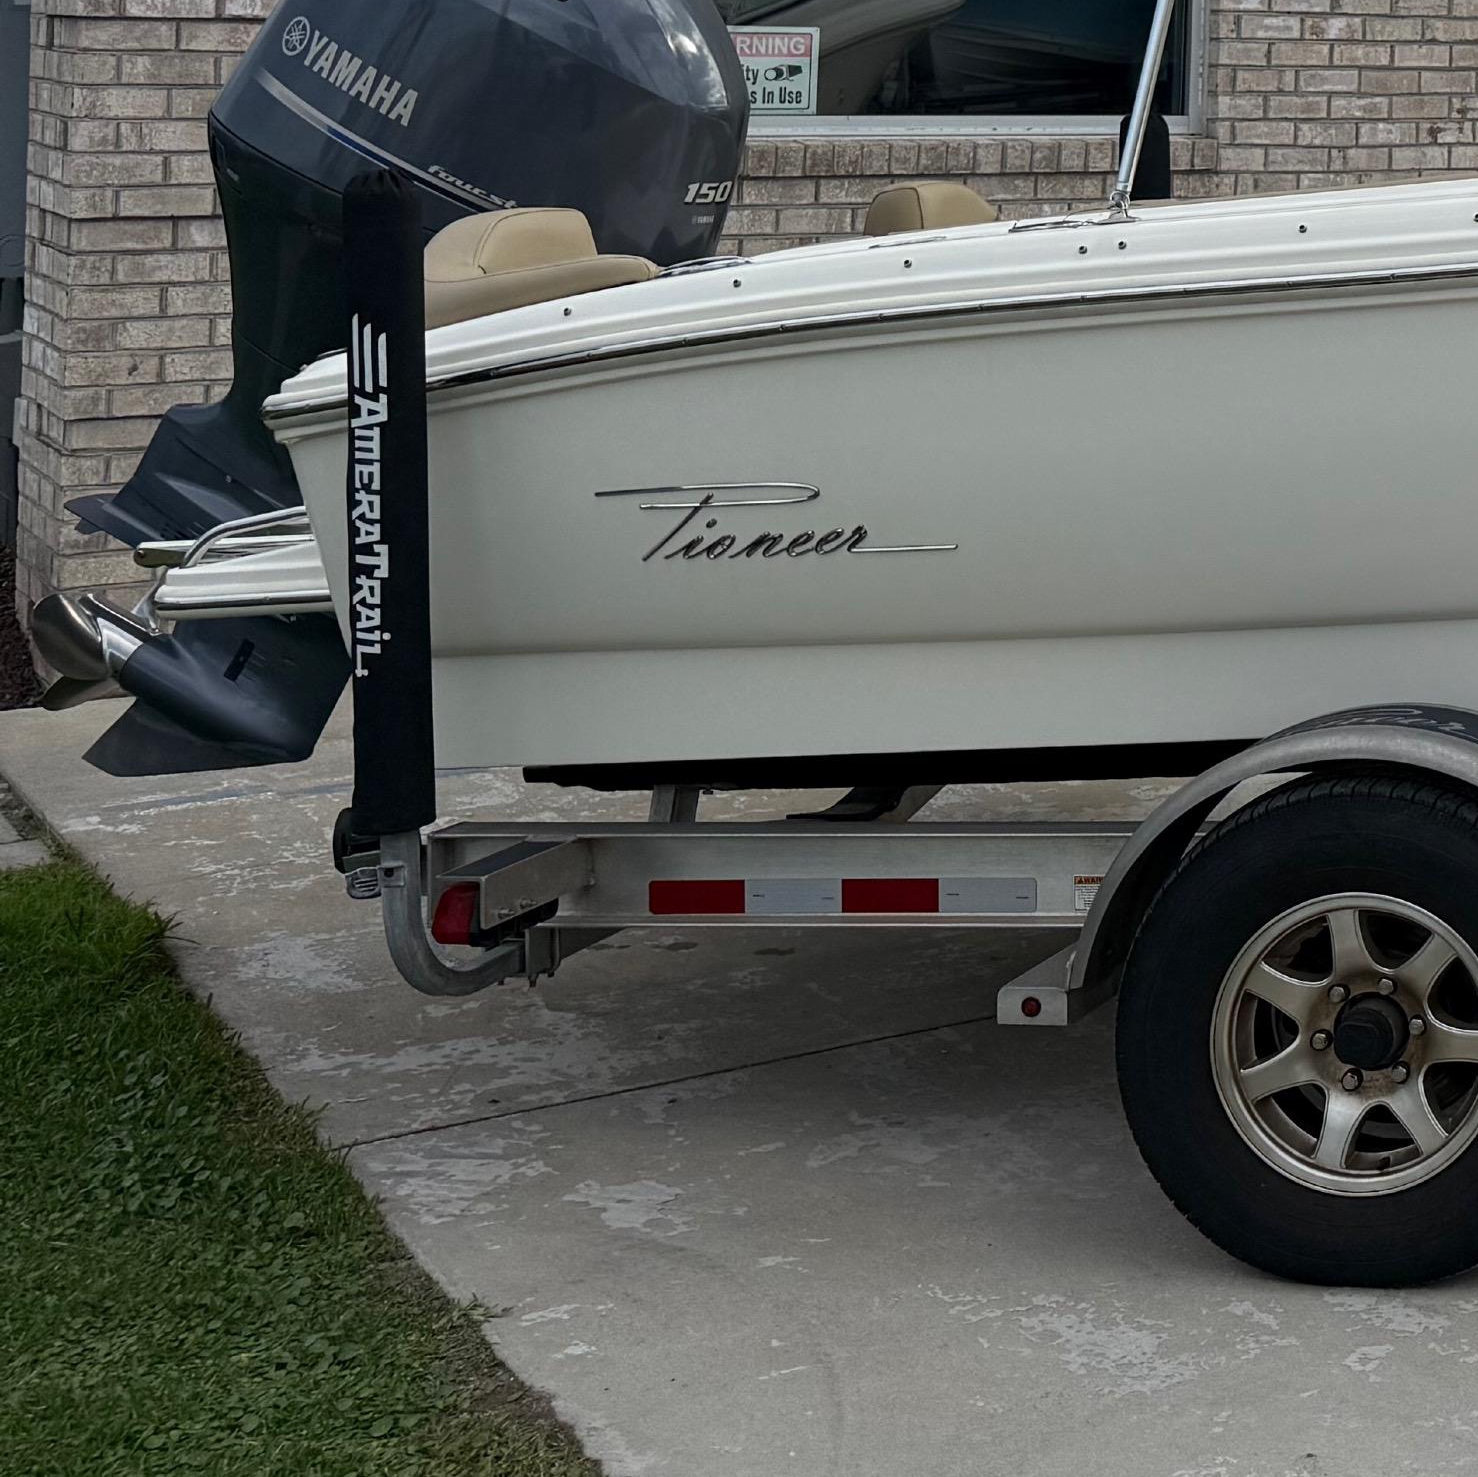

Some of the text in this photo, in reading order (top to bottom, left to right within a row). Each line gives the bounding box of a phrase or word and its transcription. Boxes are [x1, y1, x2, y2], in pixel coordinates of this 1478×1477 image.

[736, 36, 806, 55] RNING
[304, 30, 418, 127] YAMAHA
[762, 86, 775, 104] In
[779, 86, 802, 104] Use
[684, 181, 733, 203] 150
[595, 482, 958, 562] Pioneer
